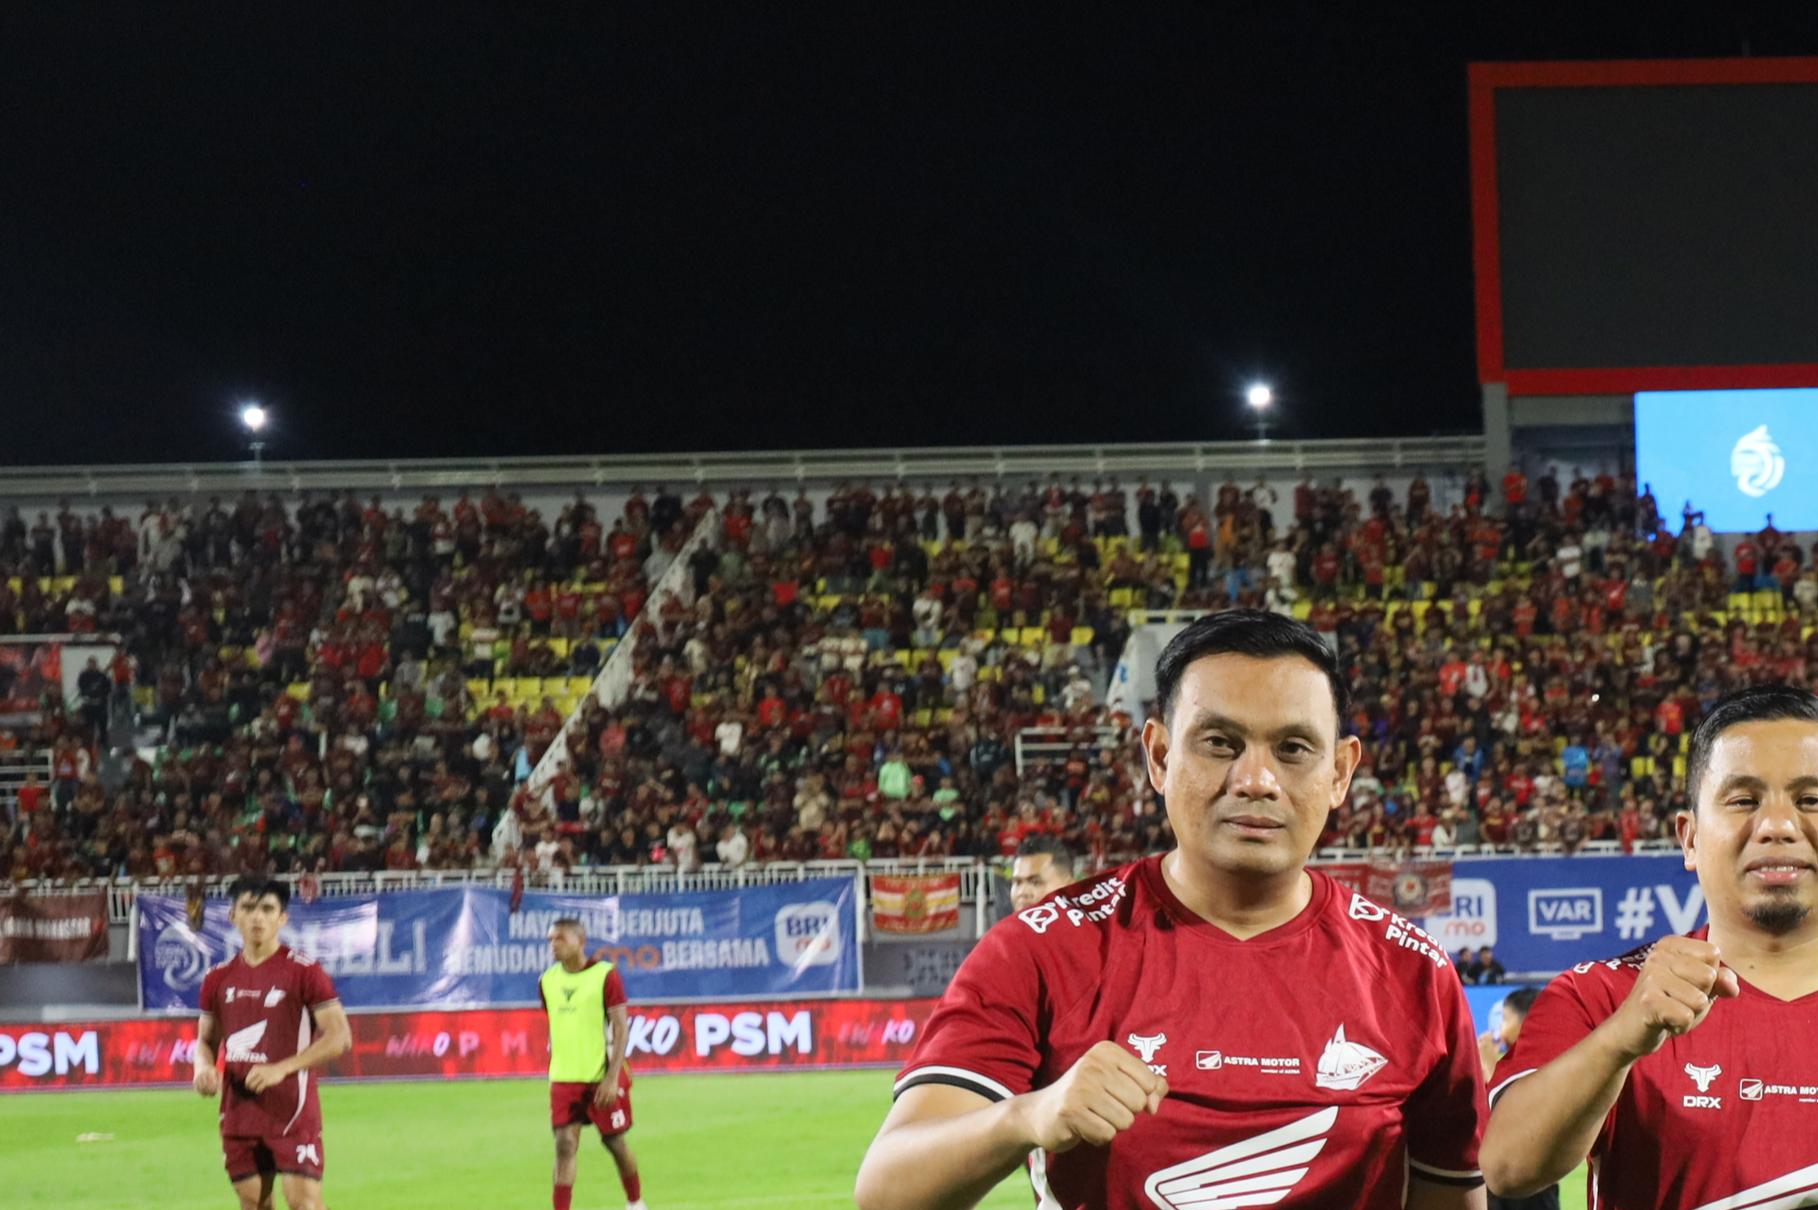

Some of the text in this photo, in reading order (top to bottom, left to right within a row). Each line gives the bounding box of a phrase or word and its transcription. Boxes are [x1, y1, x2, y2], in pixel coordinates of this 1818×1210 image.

[1055, 877, 1121, 909] Kredit
[1456, 895, 1483, 917] RI
[1540, 899, 1592, 921] VAR
[662, 938, 769, 971] BERSAMA
[1385, 924, 1448, 968] Pintar
[696, 1011, 813, 1057] PSM
[1224, 1056, 1300, 1067] ASTRA MOTOR
[1764, 1085, 1798, 1095] ASTRA
[1683, 1095, 1722, 1109] DRX
